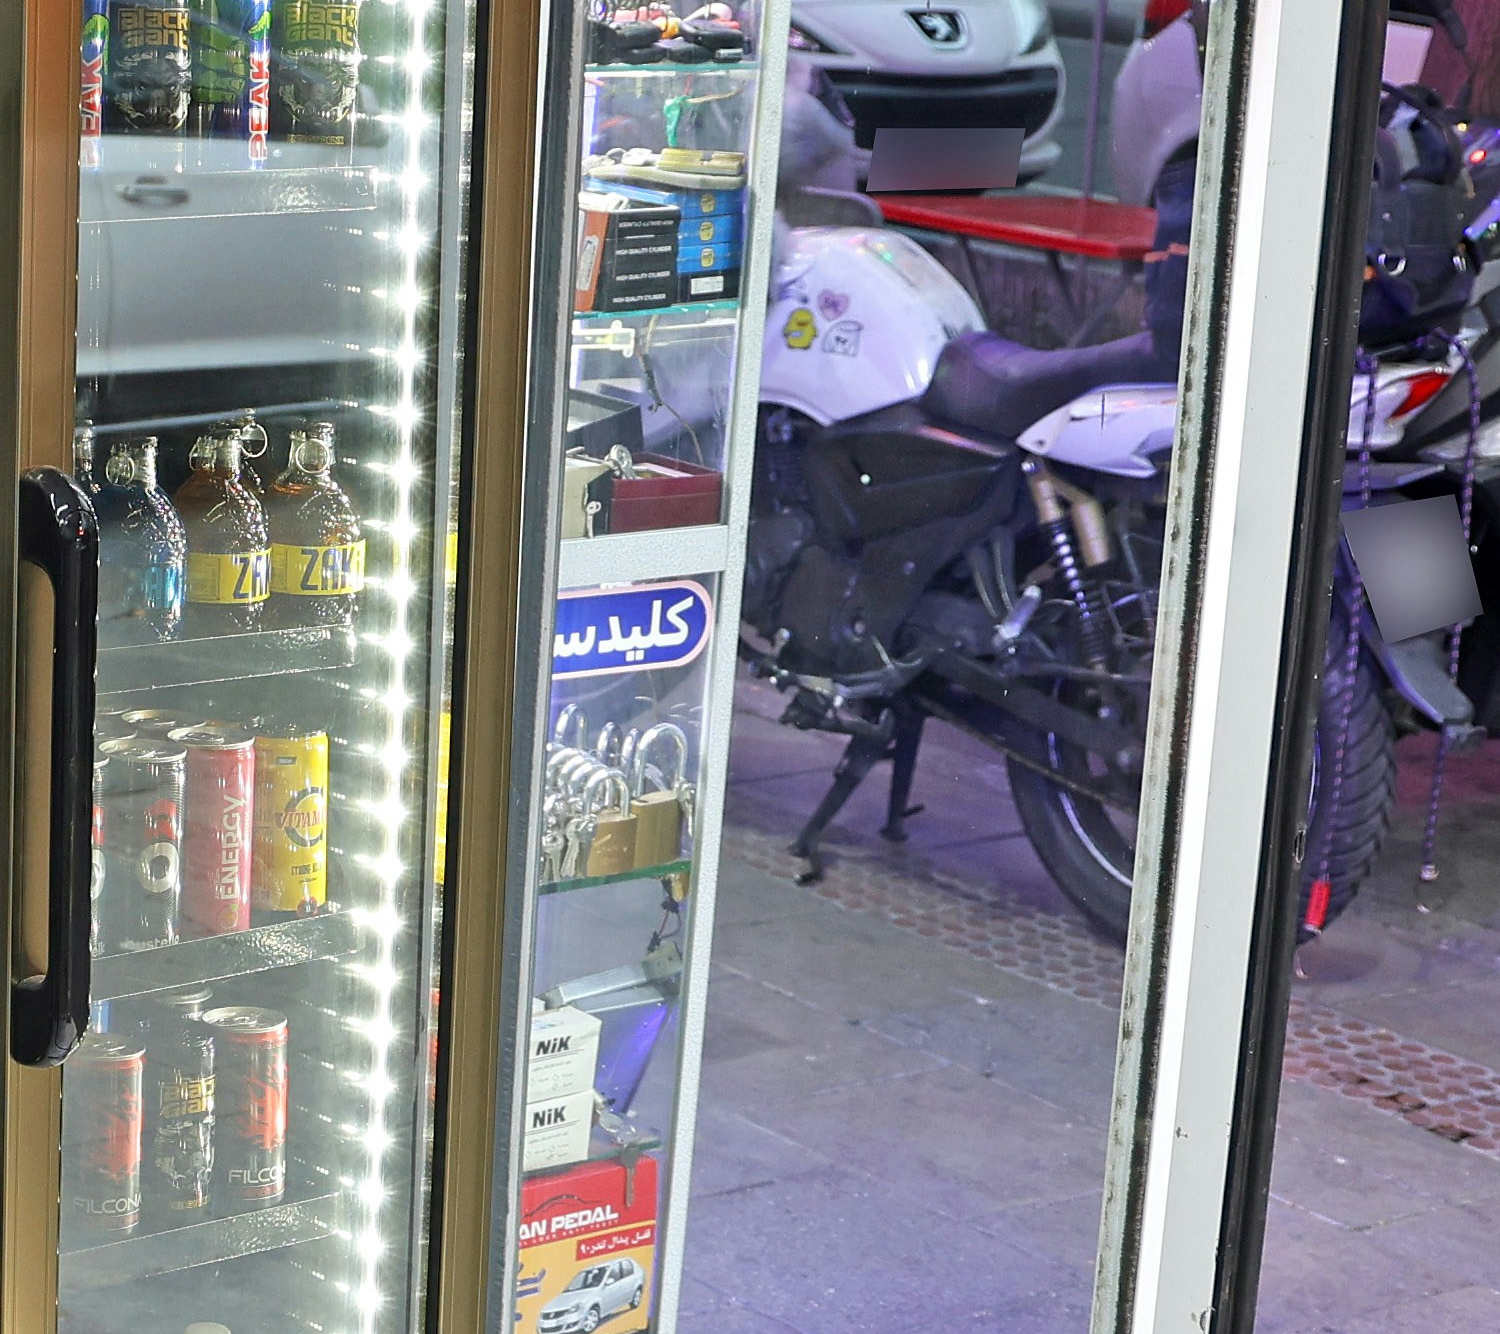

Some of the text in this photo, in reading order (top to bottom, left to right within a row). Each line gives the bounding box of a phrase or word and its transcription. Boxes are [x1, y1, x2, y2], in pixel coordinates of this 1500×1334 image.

[629, 247, 648, 255] QUALITY
[649, 245, 673, 253] CYLINDER
[629, 273, 648, 281] QUALITY
[648, 270, 671, 279] CYLINDER
[625, 295, 644, 303] QUALITY
[644, 293, 667, 301] CYLINDER
[220, 793, 248, 901] ENERGY
[535, 1035, 572, 1056] NiK
[532, 1105, 567, 1128] NiK
[550, 1204, 620, 1233] PEDAL
[607, 1234, 630, 1250] پدال
[631, 1228, 652, 1244] قفل
